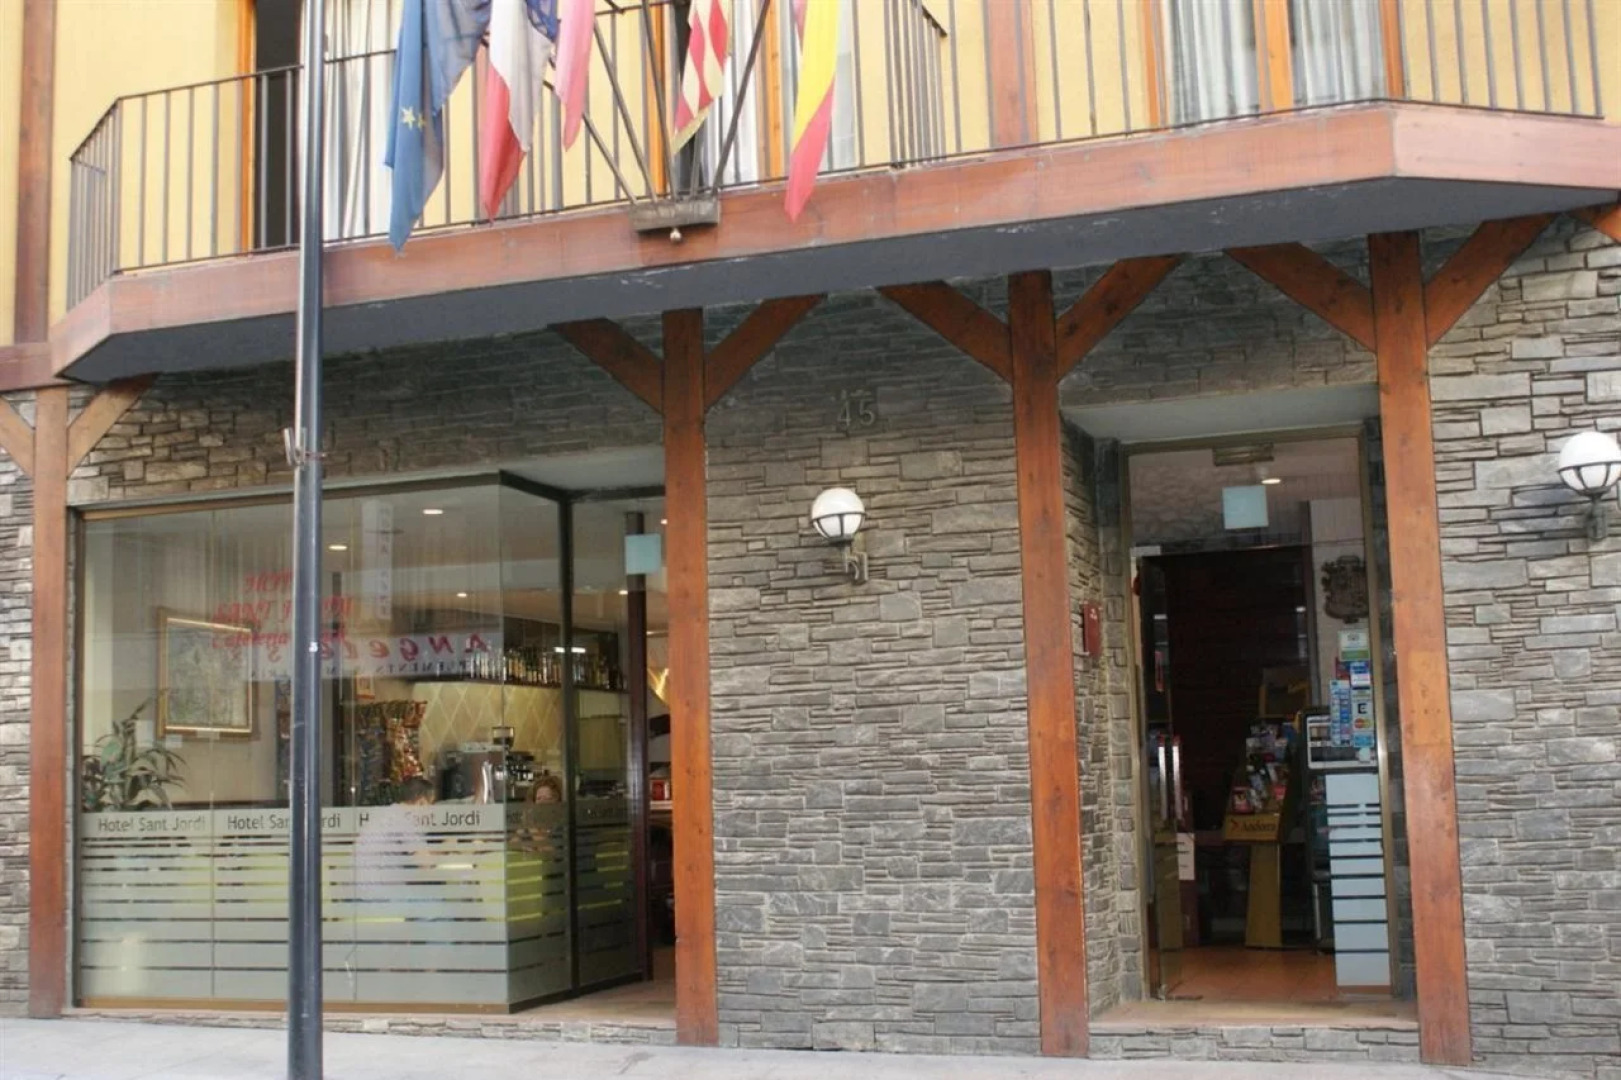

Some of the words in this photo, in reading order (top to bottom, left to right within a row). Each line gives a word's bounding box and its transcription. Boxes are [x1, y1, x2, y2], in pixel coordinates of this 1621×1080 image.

[837, 397, 876, 427] 45
[98, 817, 133, 832] Hotel
[138, 816, 167, 832] Sant
[172, 815, 206, 831] Jordi
[227, 815, 264, 830] Hotel
[322, 813, 341, 829] rdi
[442, 812, 480, 827] Jordi
